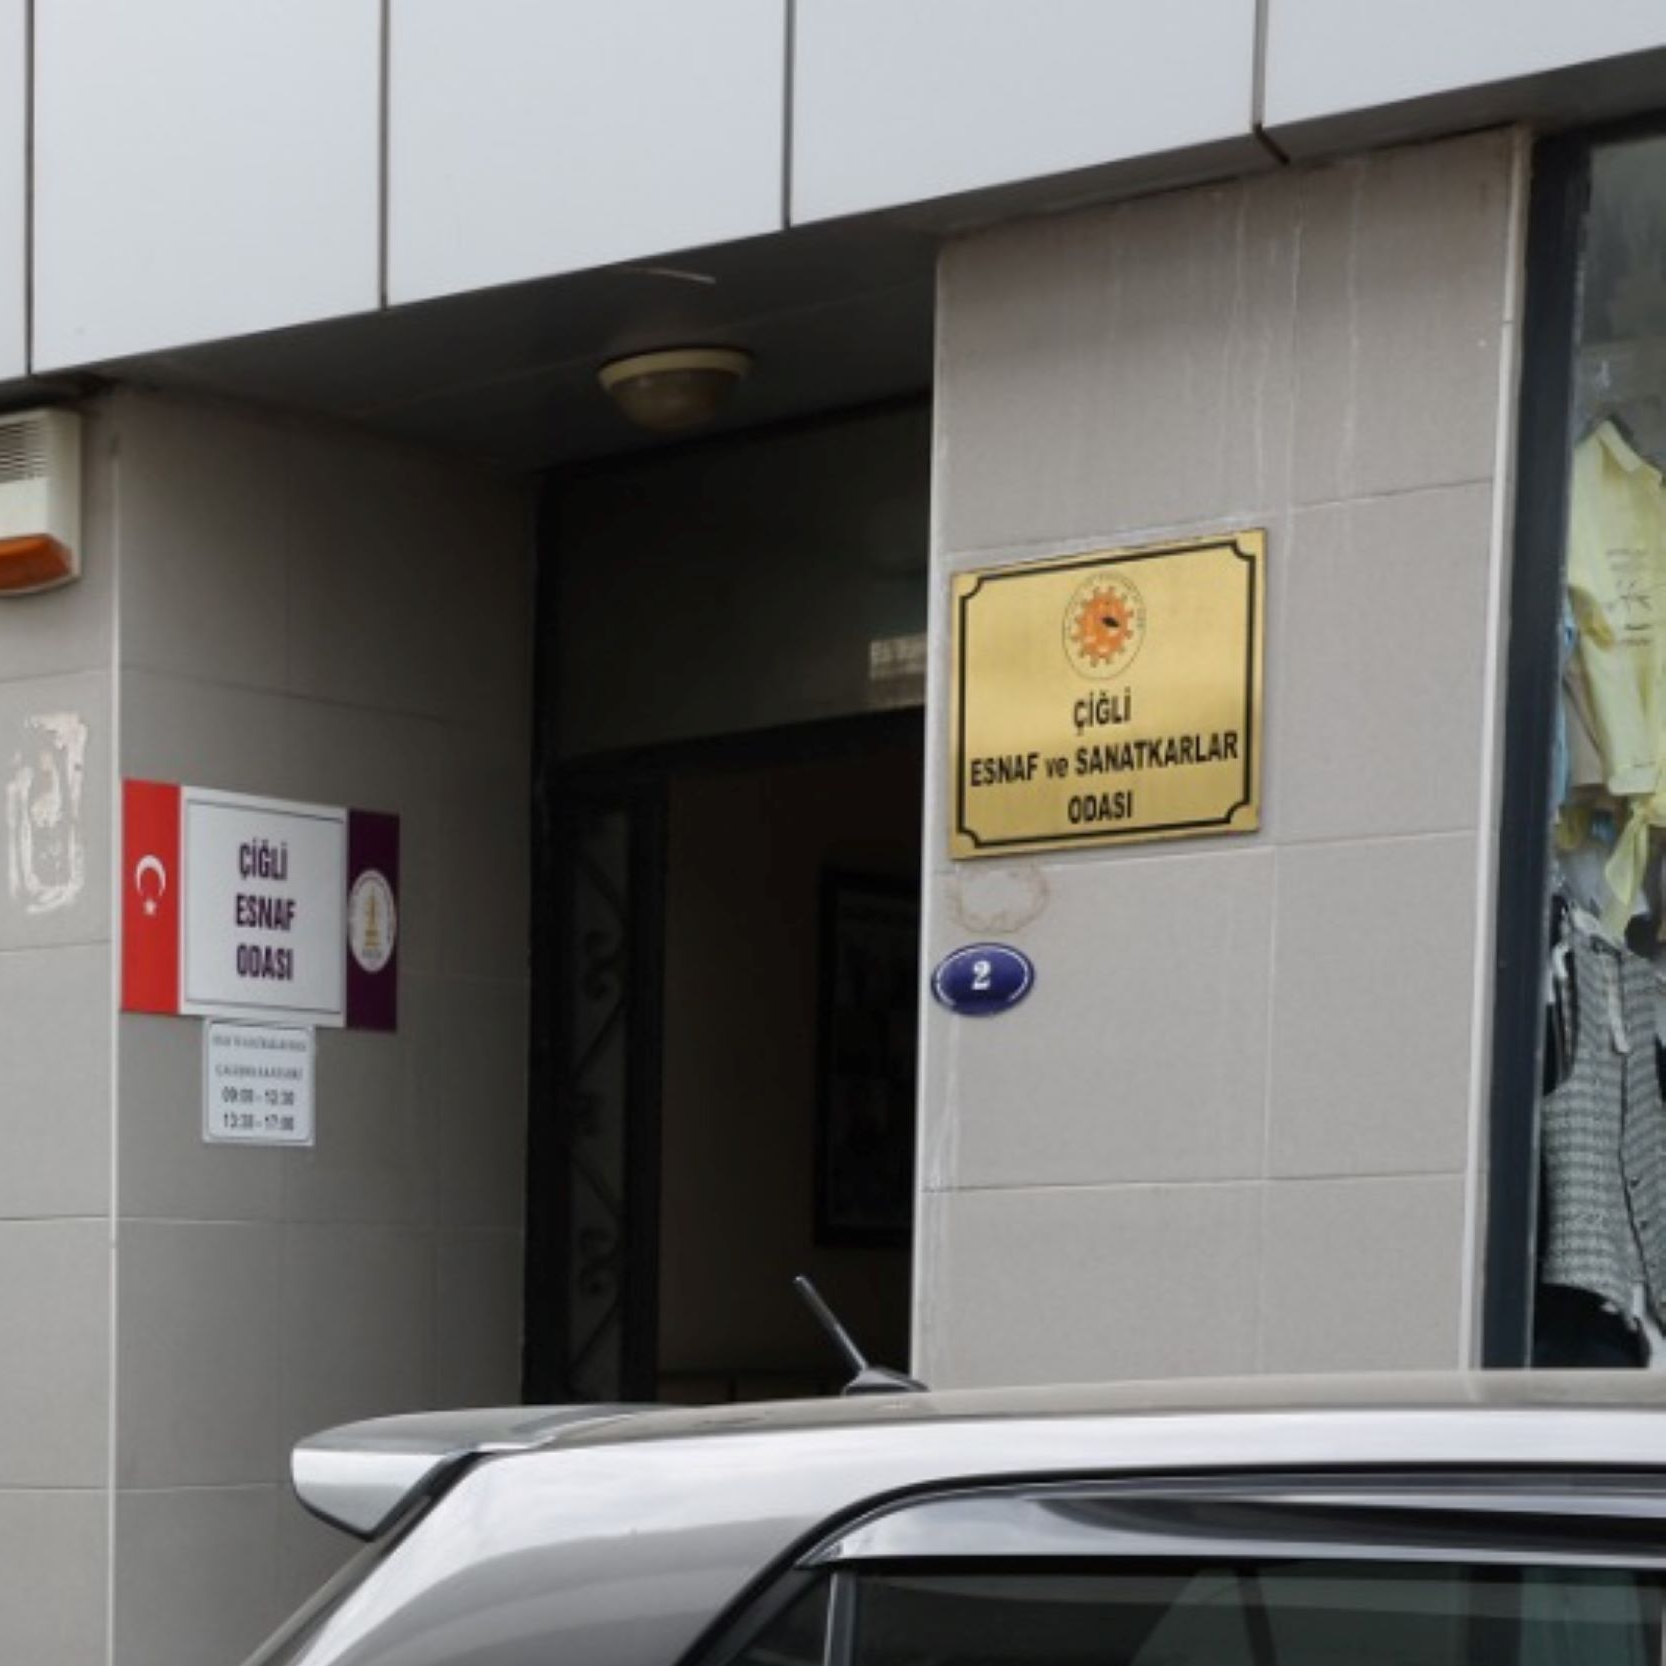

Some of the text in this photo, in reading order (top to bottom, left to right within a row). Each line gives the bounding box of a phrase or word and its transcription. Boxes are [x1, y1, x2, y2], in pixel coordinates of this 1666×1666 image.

[1073, 687, 1132, 737] ÇİĞLİ
[970, 730, 1238, 787] ESNAF ve SANATKARLAR
[1068, 791, 1134, 824] ODASI
[238, 838, 288, 881] ÇİĞLİ
[235, 894, 295, 931] ESNAF
[236, 944, 294, 981] ODASI
[971, 960, 992, 990] 2
